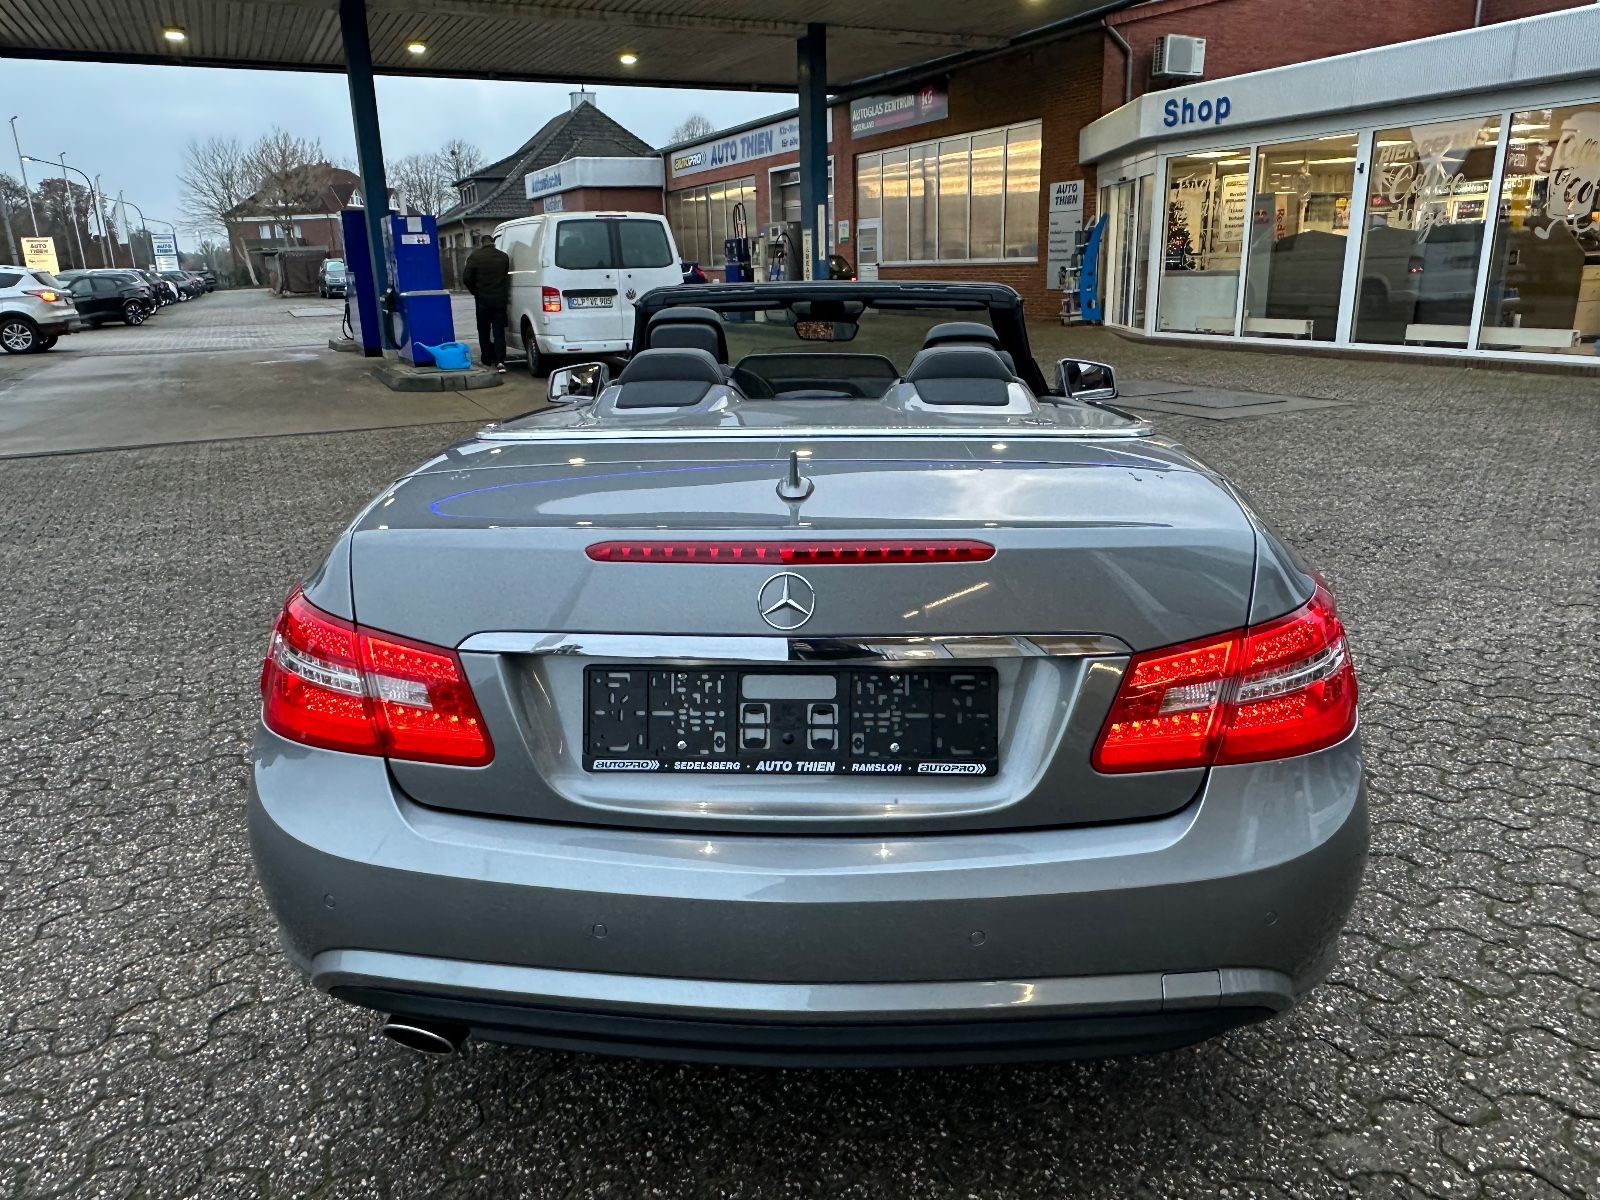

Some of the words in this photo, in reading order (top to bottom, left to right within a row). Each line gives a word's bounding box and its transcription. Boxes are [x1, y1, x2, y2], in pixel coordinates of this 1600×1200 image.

[853, 104, 883, 121] AUTOGLAS
[884, 95, 915, 112] ZENTRUM
[1163, 96, 1231, 127] Shop
[711, 142, 738, 166] AUTO
[740, 130, 774, 158] THIEN
[1380, 143, 1415, 161] HIER
[1056, 183, 1078, 195] AUTO
[1055, 195, 1078, 206] THIEN
[673, 761, 741, 770] SEDELSBERG
[755, 760, 794, 772] AUTO
[796, 761, 836, 773] THIEN
[851, 763, 902, 772] RAMSLOH
